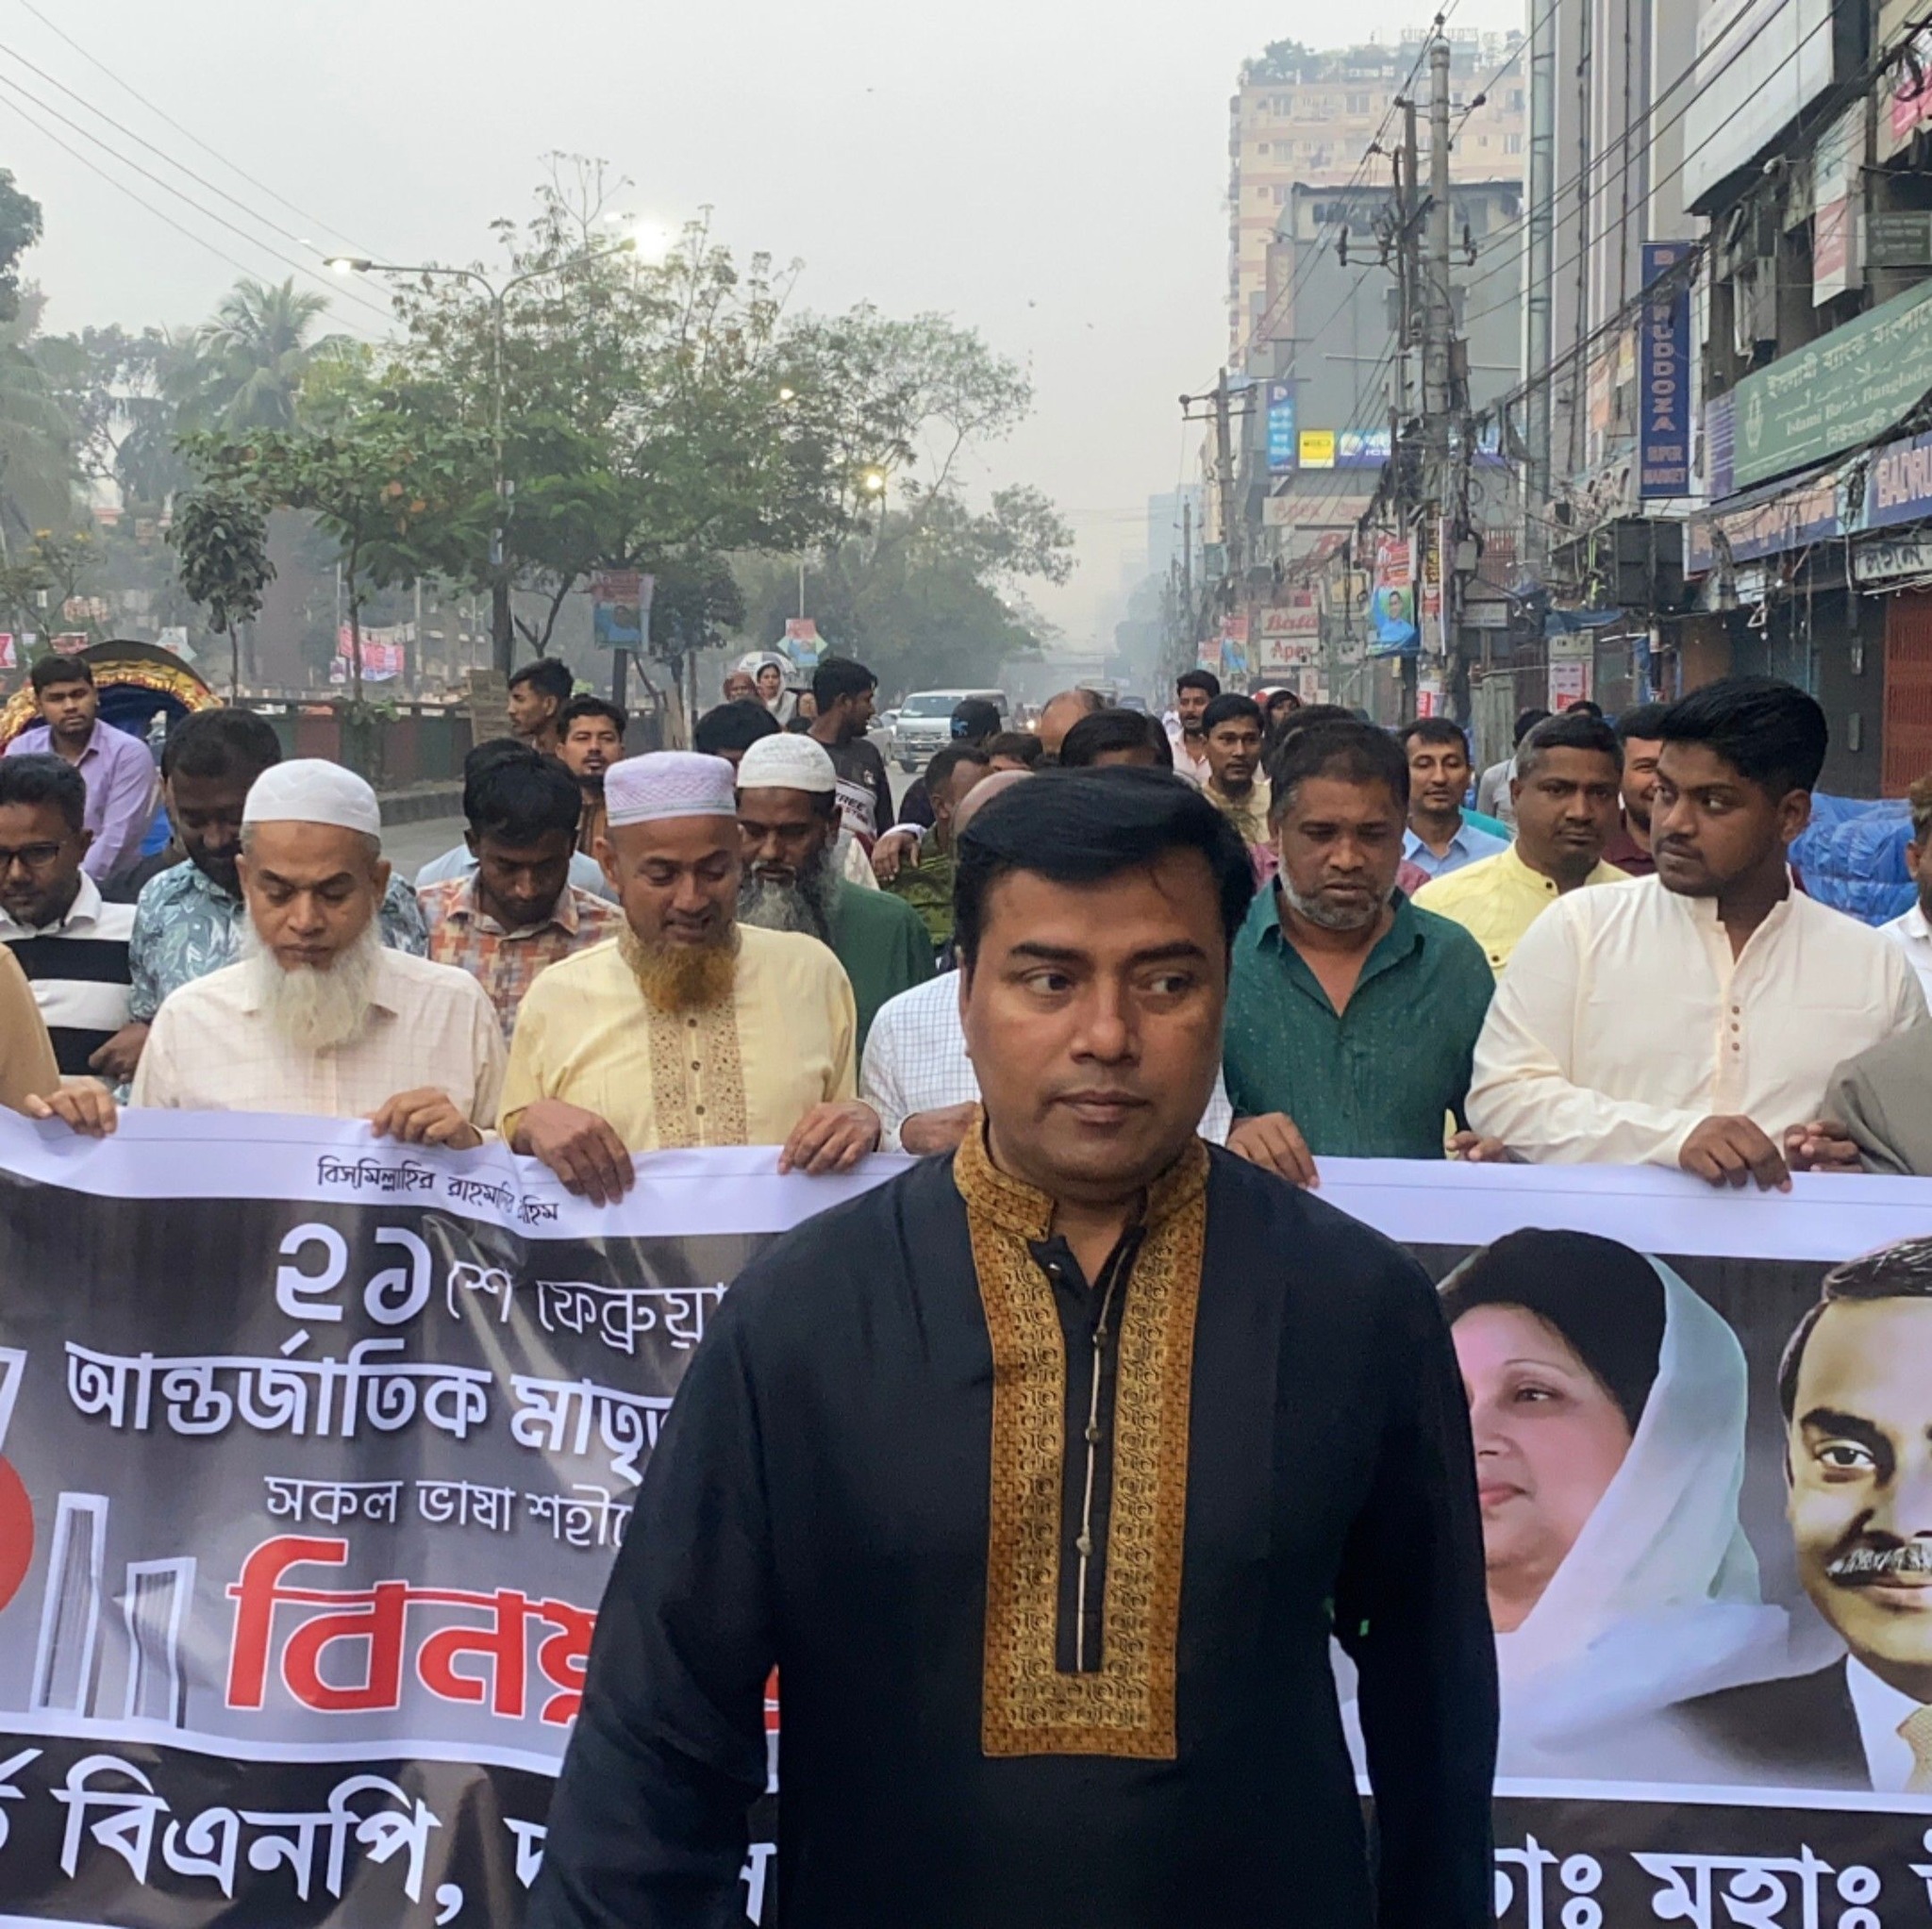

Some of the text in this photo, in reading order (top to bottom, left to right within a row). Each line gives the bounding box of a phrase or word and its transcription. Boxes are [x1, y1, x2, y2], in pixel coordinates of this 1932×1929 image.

[1265, 613, 1318, 630] Bata
[1270, 640, 1313, 663] Apex
[64, 1328, 675, 1487] আন্তর্জাতিক মাতৃ
[264, 1475, 635, 1548] সকল ভাষা শহী
